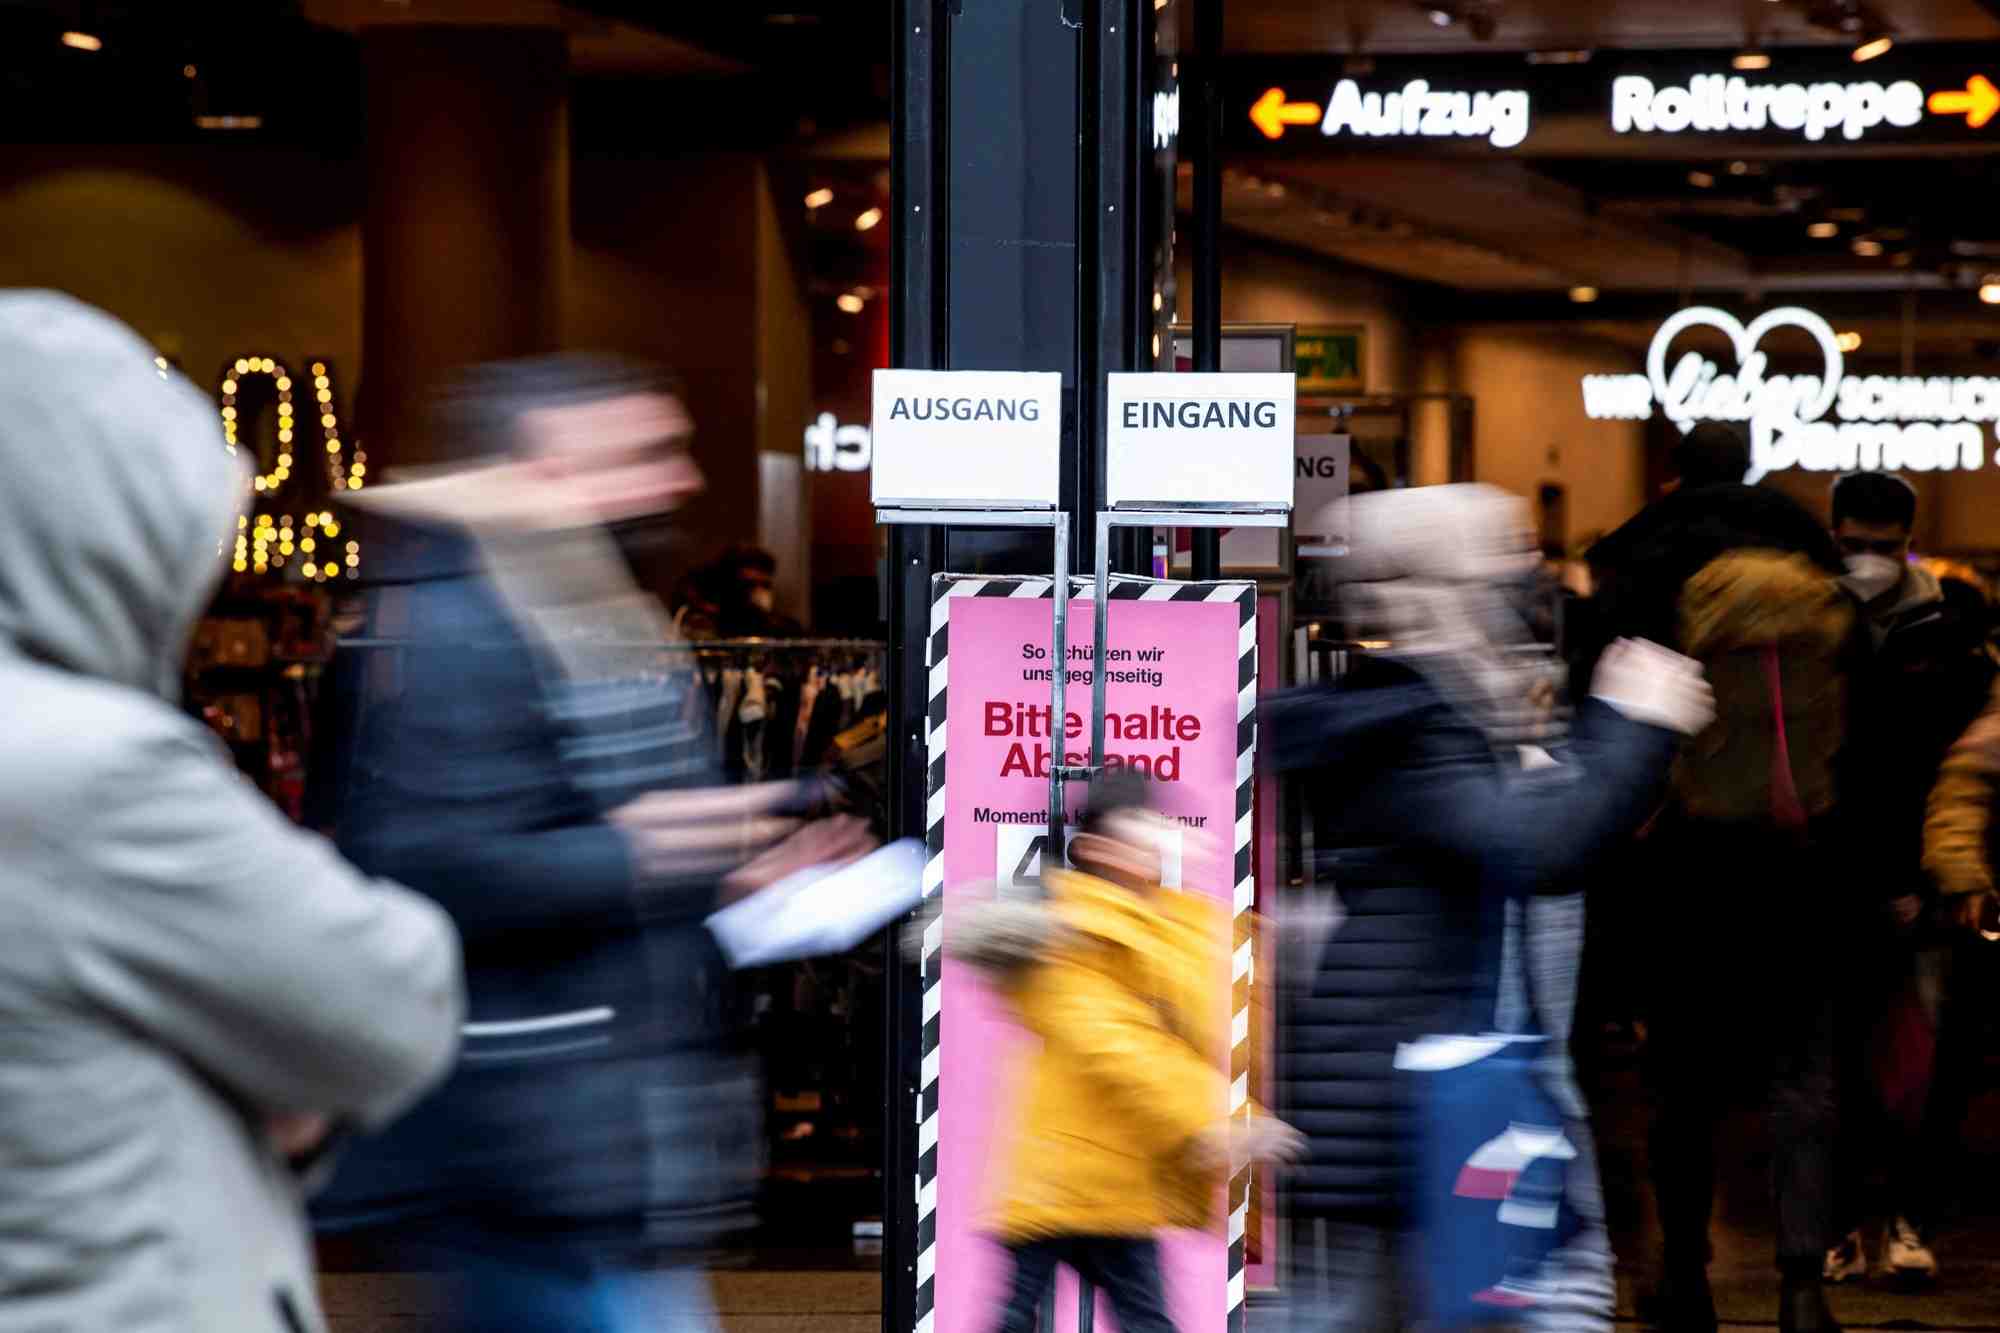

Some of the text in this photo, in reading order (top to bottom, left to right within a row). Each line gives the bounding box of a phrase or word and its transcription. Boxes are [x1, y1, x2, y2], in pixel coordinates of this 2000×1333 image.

[1322, 80, 1528, 147] Aufzug
[1612, 74, 1923, 140] Rolltreppe
[890, 398, 1040, 422] AUSGANG
[1123, 402, 1276, 429] EINGANG
[1296, 456, 1335, 478] NG
[1022, 643, 1165, 662] So chüzen wir
[1022, 667, 1163, 687] uns gegnseitig
[984, 701, 1083, 738] Bitte
[973, 807, 1069, 824] Moment
[1177, 815, 1208, 828] nur
